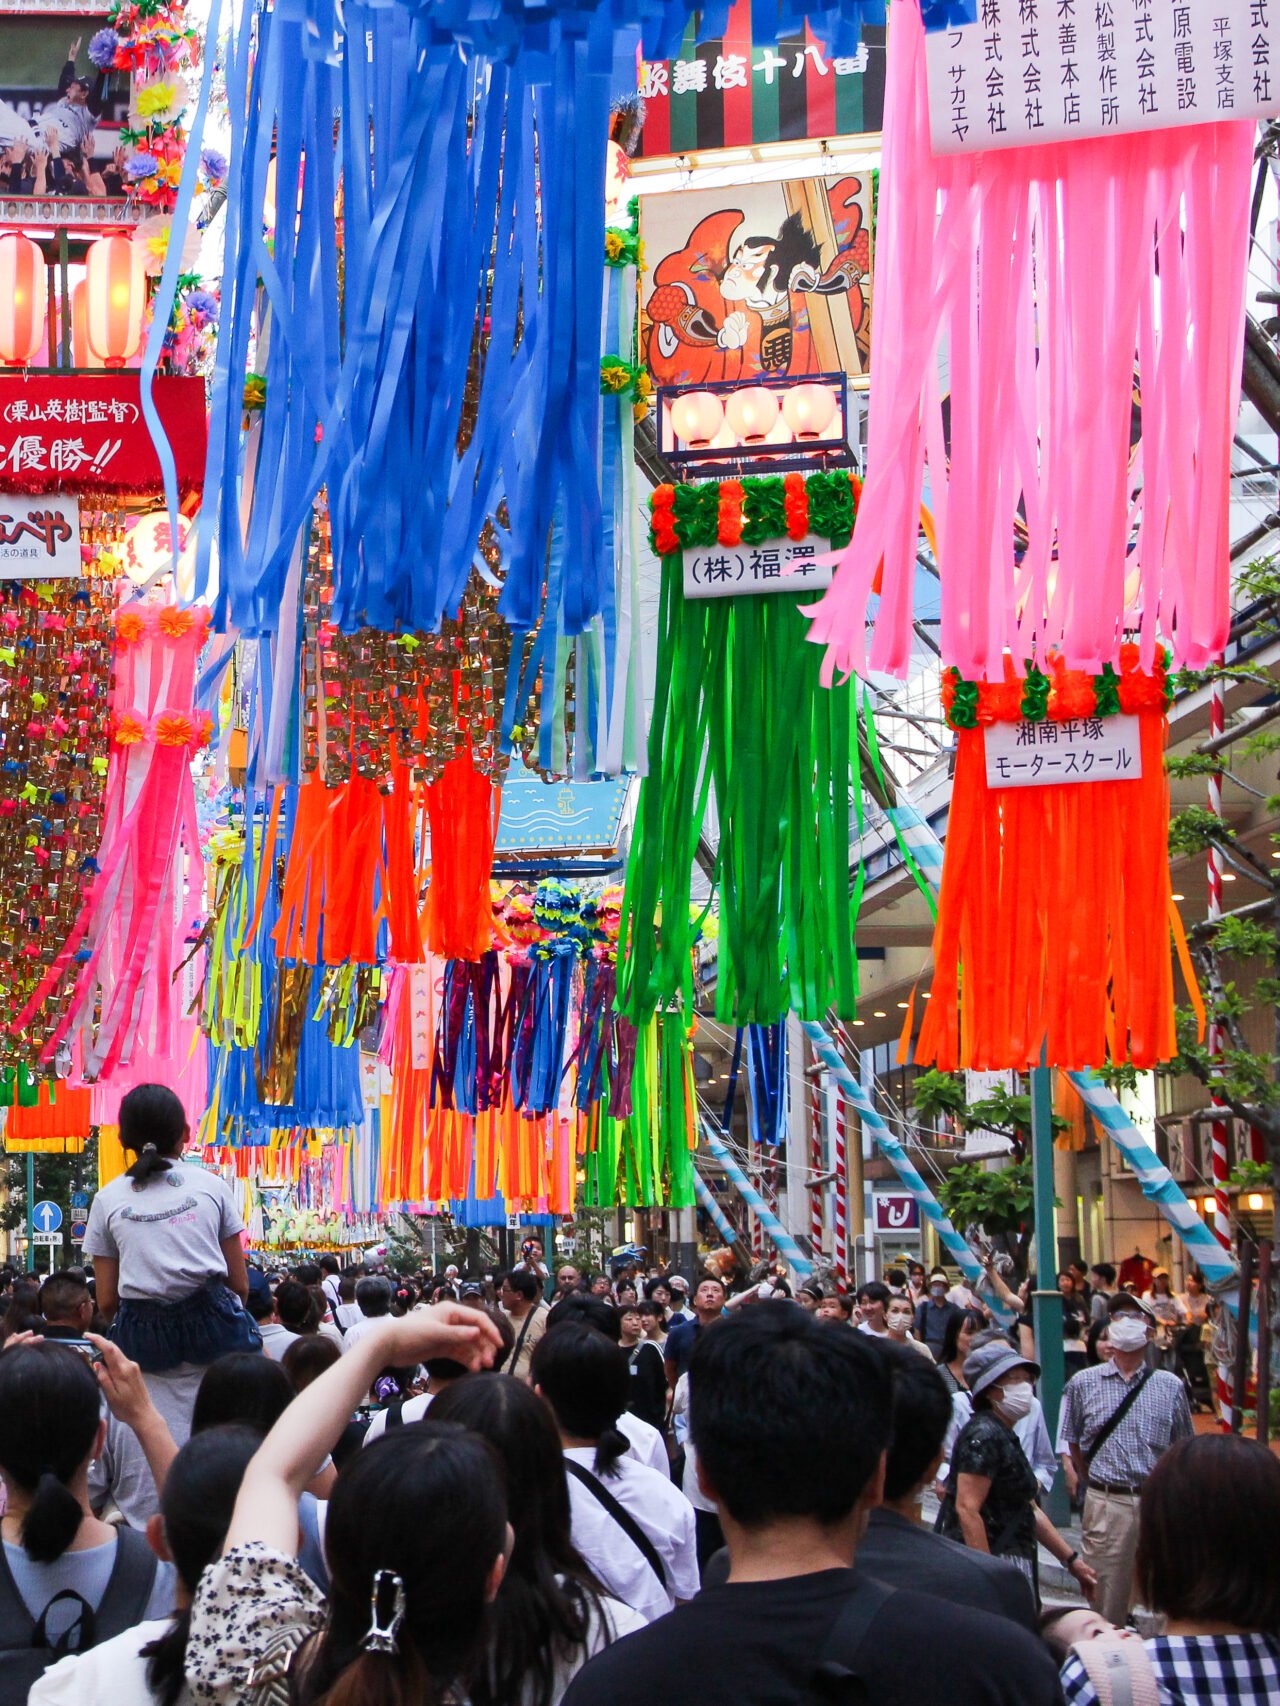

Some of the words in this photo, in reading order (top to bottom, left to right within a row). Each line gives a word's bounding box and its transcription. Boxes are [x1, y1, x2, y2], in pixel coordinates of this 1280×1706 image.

[1173, 0, 1198, 111] 原電設
[1212, 17, 1236, 110] 平塚支店
[948, 65, 970, 143] サカエヤ
[996, 748, 1132, 779] モータースクール
[1016, 717, 1104, 747] 湘南平塚
